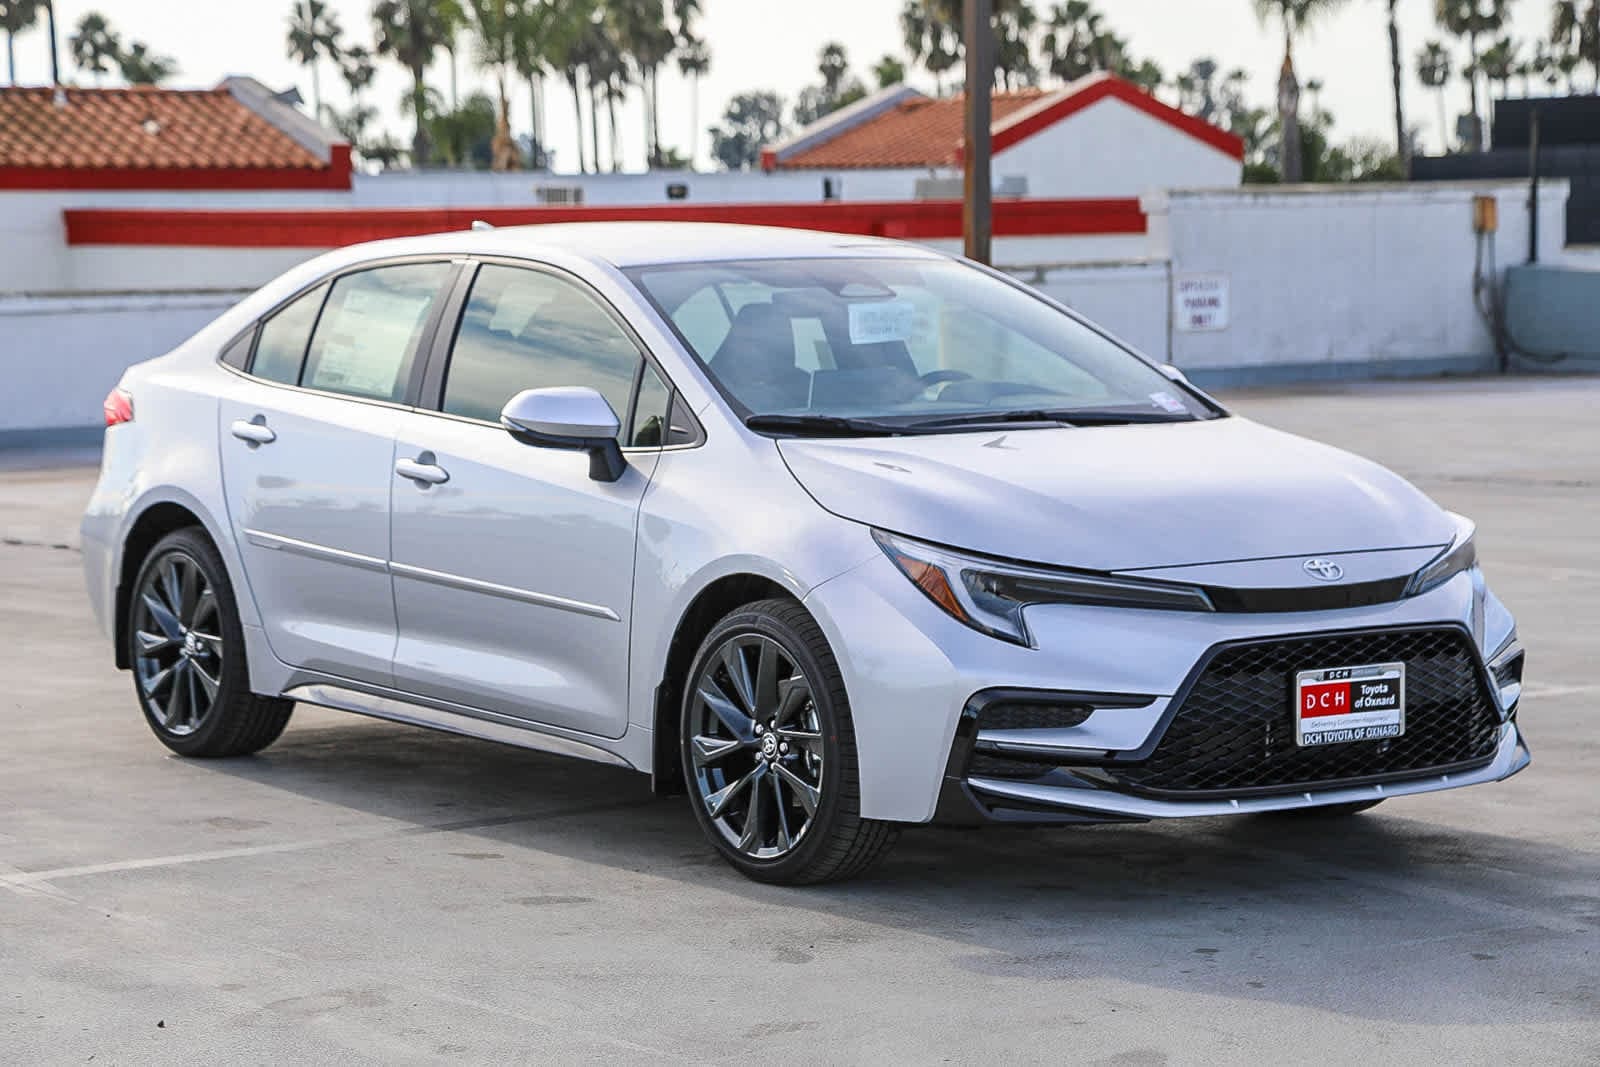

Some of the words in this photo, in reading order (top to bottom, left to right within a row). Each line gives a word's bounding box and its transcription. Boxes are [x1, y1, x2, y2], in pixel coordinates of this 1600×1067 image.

[1361, 684, 1389, 697] Toyota
[1354, 697, 1364, 709] of
[1364, 694, 1396, 707] Oxnard
[1304, 732, 1323, 745] DCH
[1323, 729, 1354, 743] TOYOTA
[1354, 729, 1365, 738] OF
[1366, 725, 1399, 738] OXNARD
